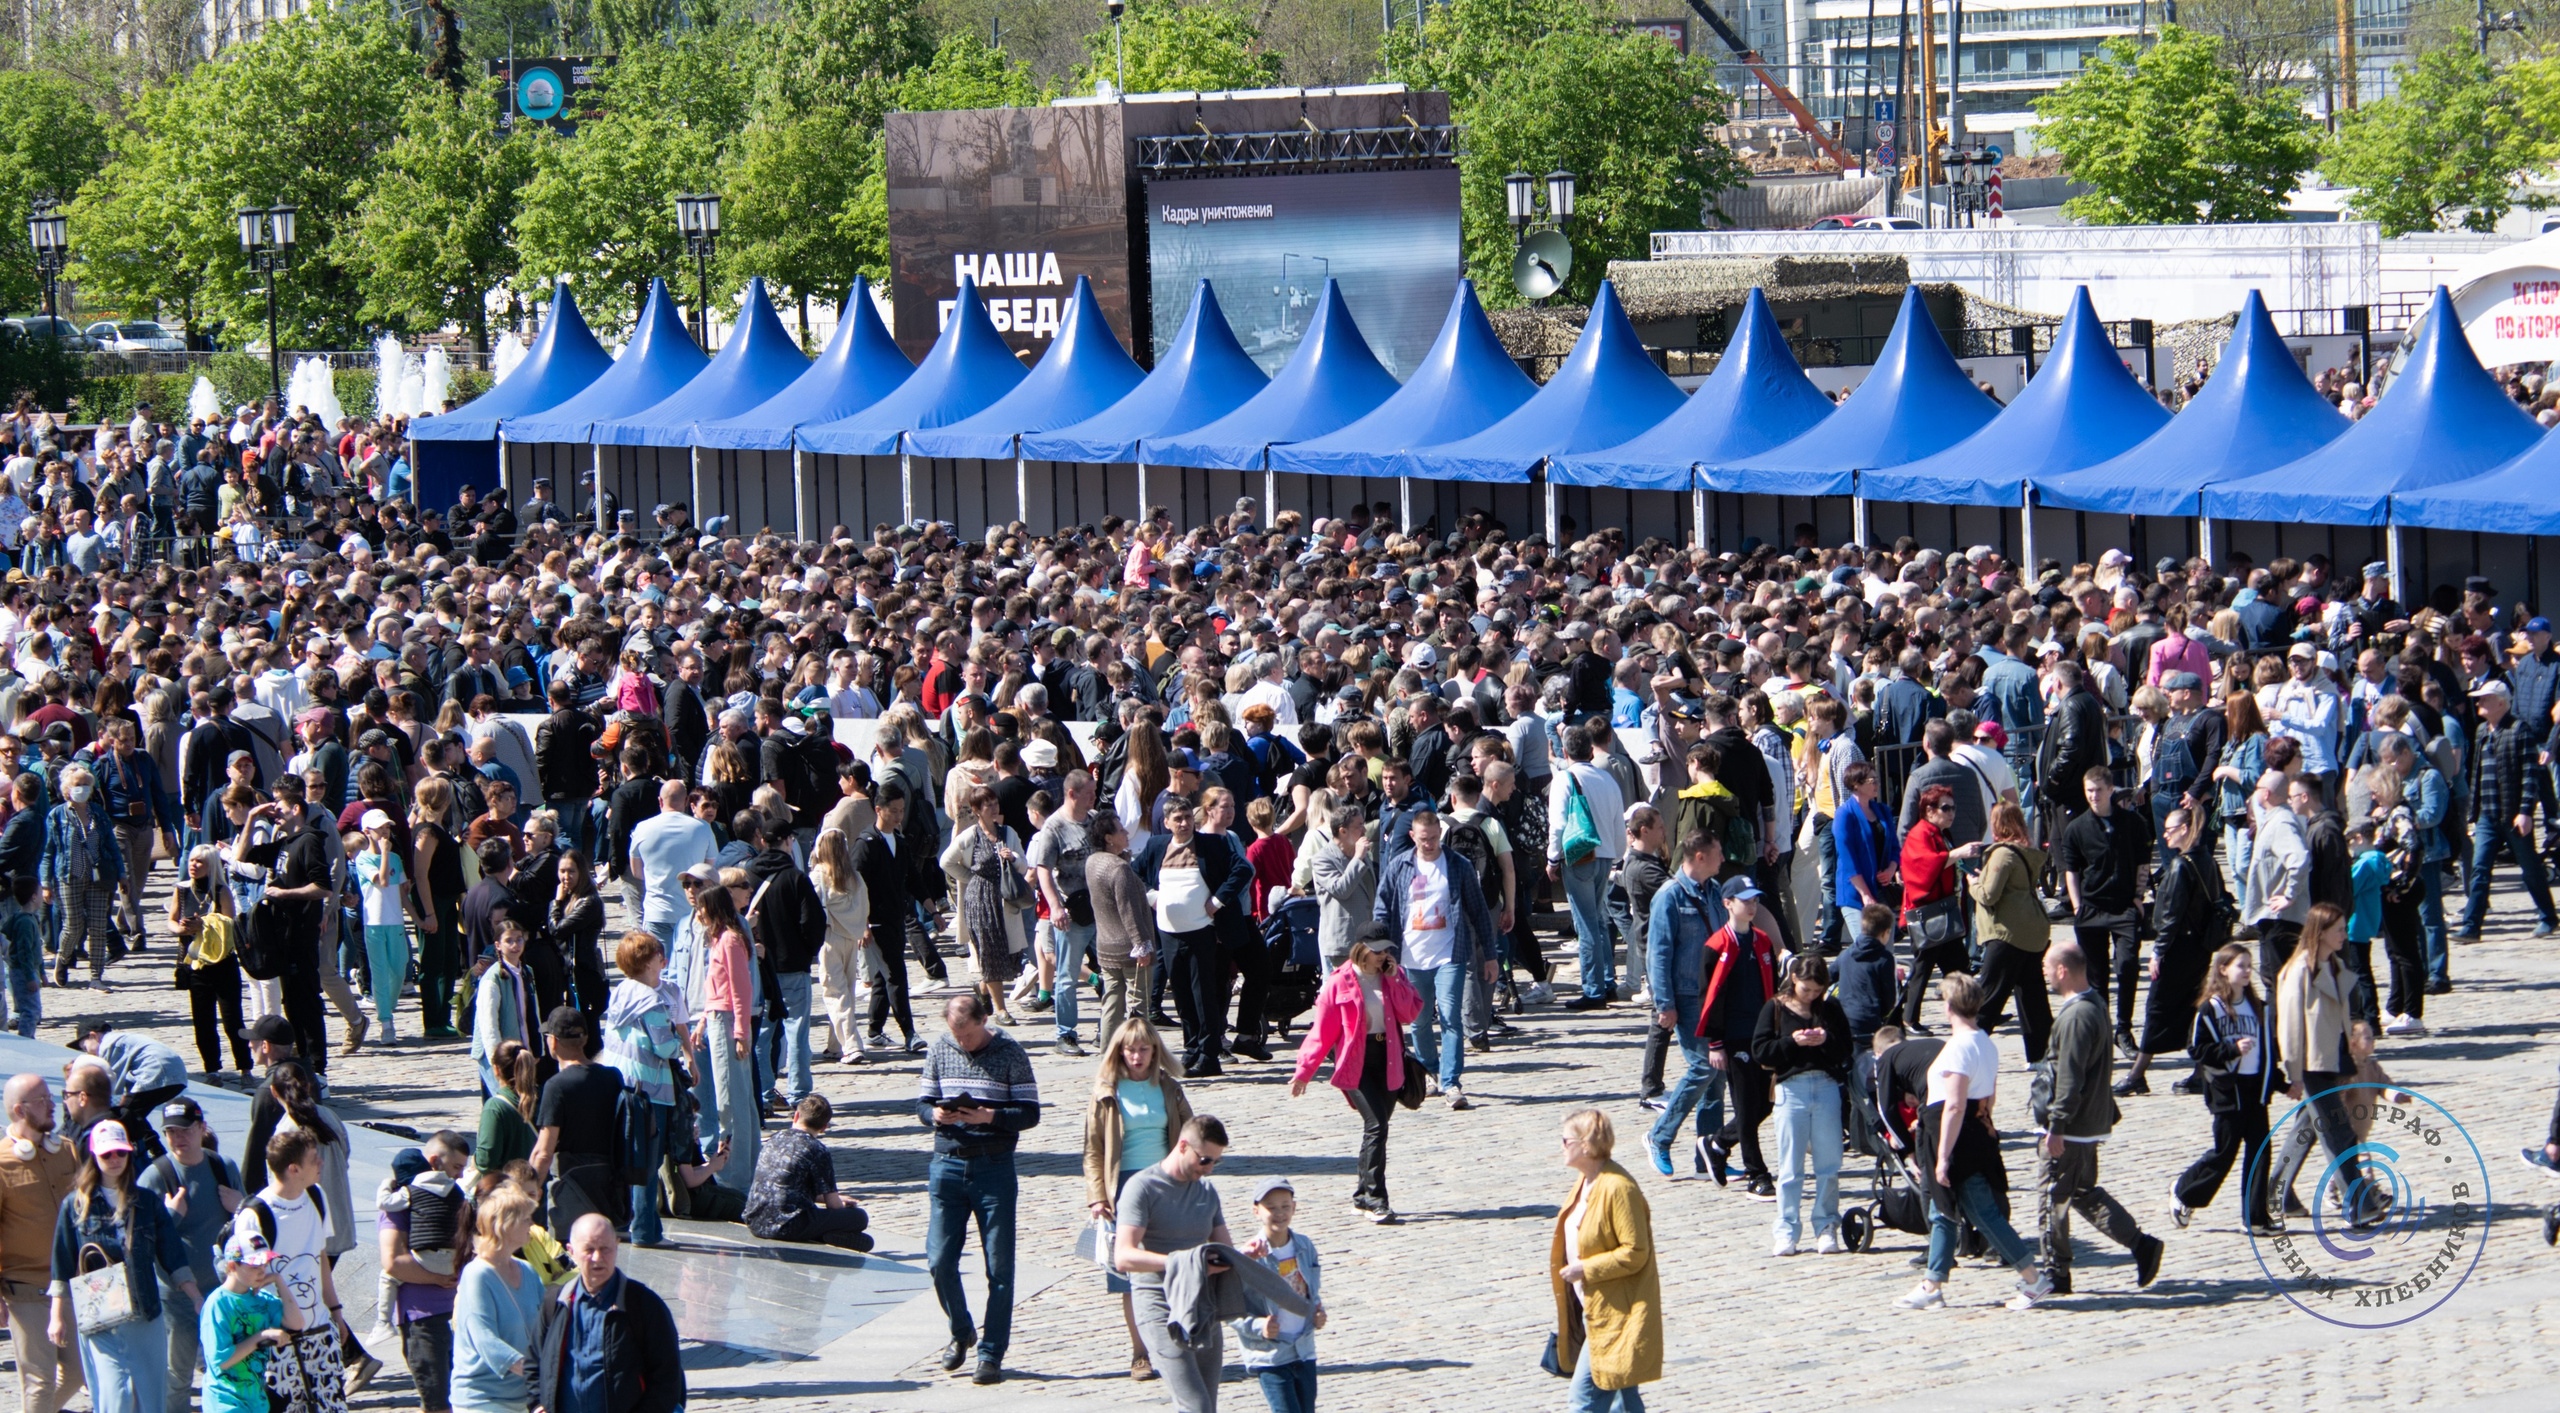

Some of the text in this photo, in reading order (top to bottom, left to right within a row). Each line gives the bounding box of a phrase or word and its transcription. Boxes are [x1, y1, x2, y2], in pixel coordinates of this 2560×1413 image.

[1880, 129, 1891, 138] 80
[1162, 204, 1273, 226] Кадры уничтожения
[955, 252, 1063, 288] НАША
[938, 298, 1073, 339] ПБЕД
